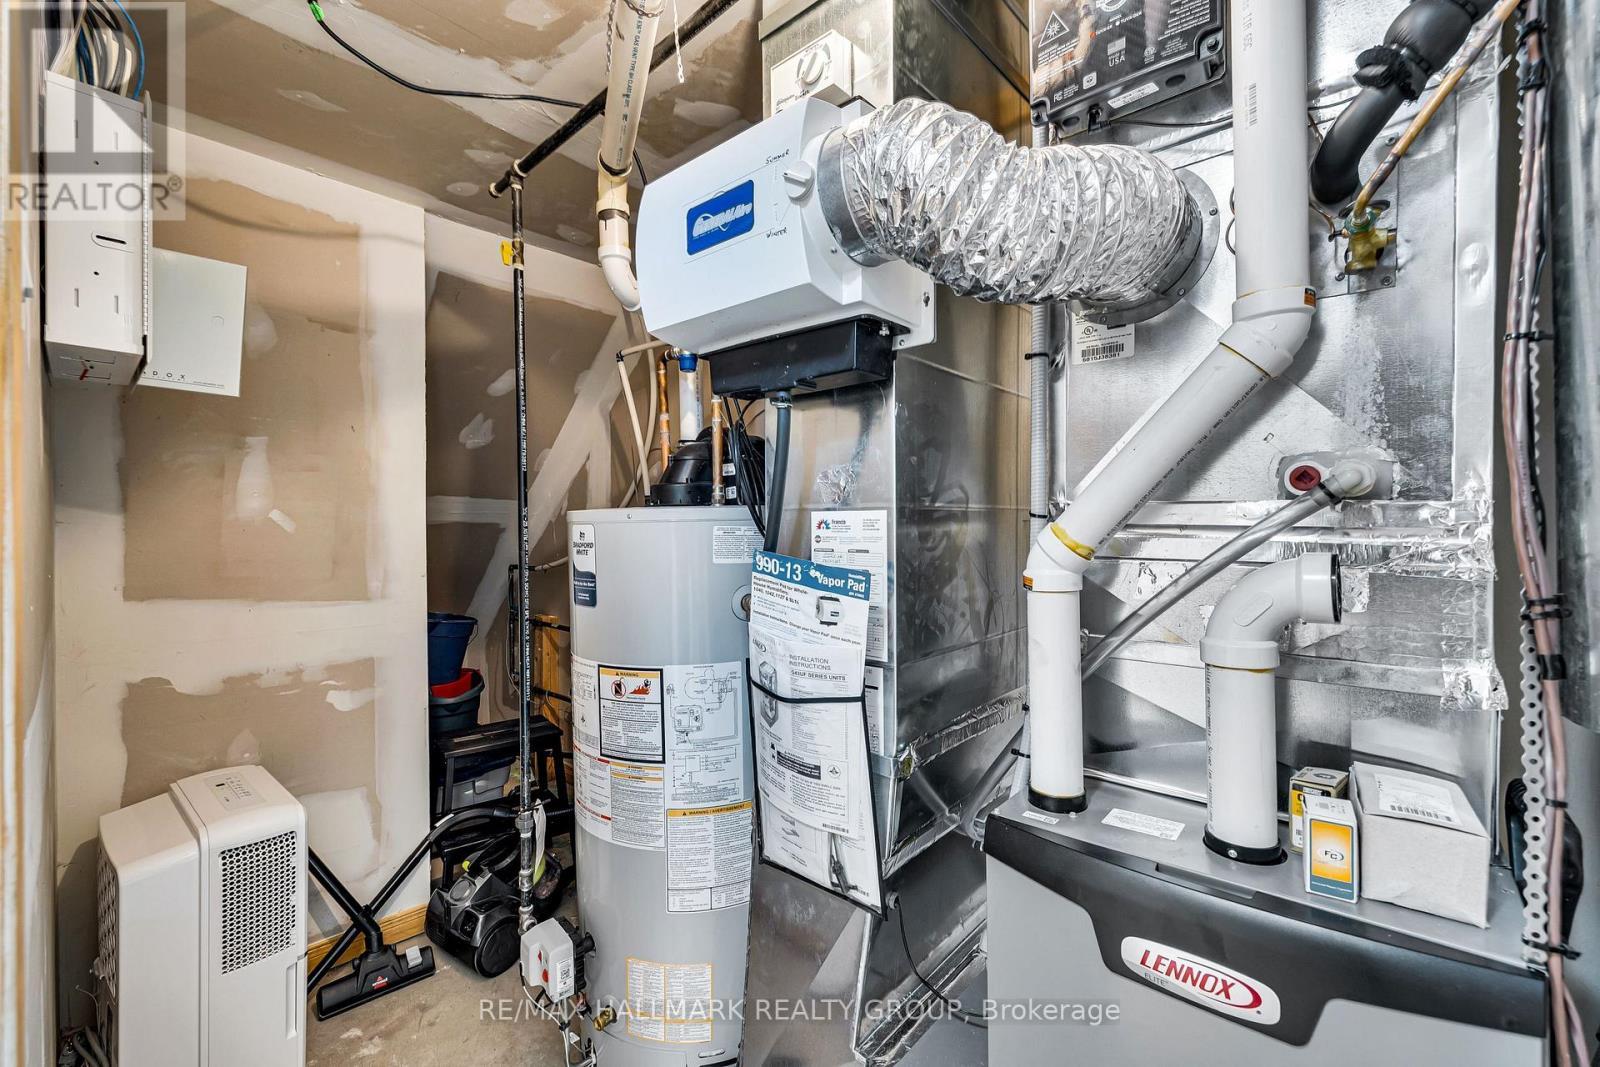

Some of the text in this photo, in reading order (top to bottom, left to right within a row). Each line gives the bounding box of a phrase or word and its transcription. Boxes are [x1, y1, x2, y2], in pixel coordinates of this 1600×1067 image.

[1109, 55, 1125, 67] USA
[767, 226, 787, 239] WINTER
[755, 554, 801, 581] 990-13
[817, 573, 865, 593] Vapor Pad
[789, 654, 829, 664] INSTALLATION
[789, 661, 831, 671] INSTRUCTIONS
[1325, 850, 1337, 860] FC
[1139, 949, 1236, 1001] LENNOX
